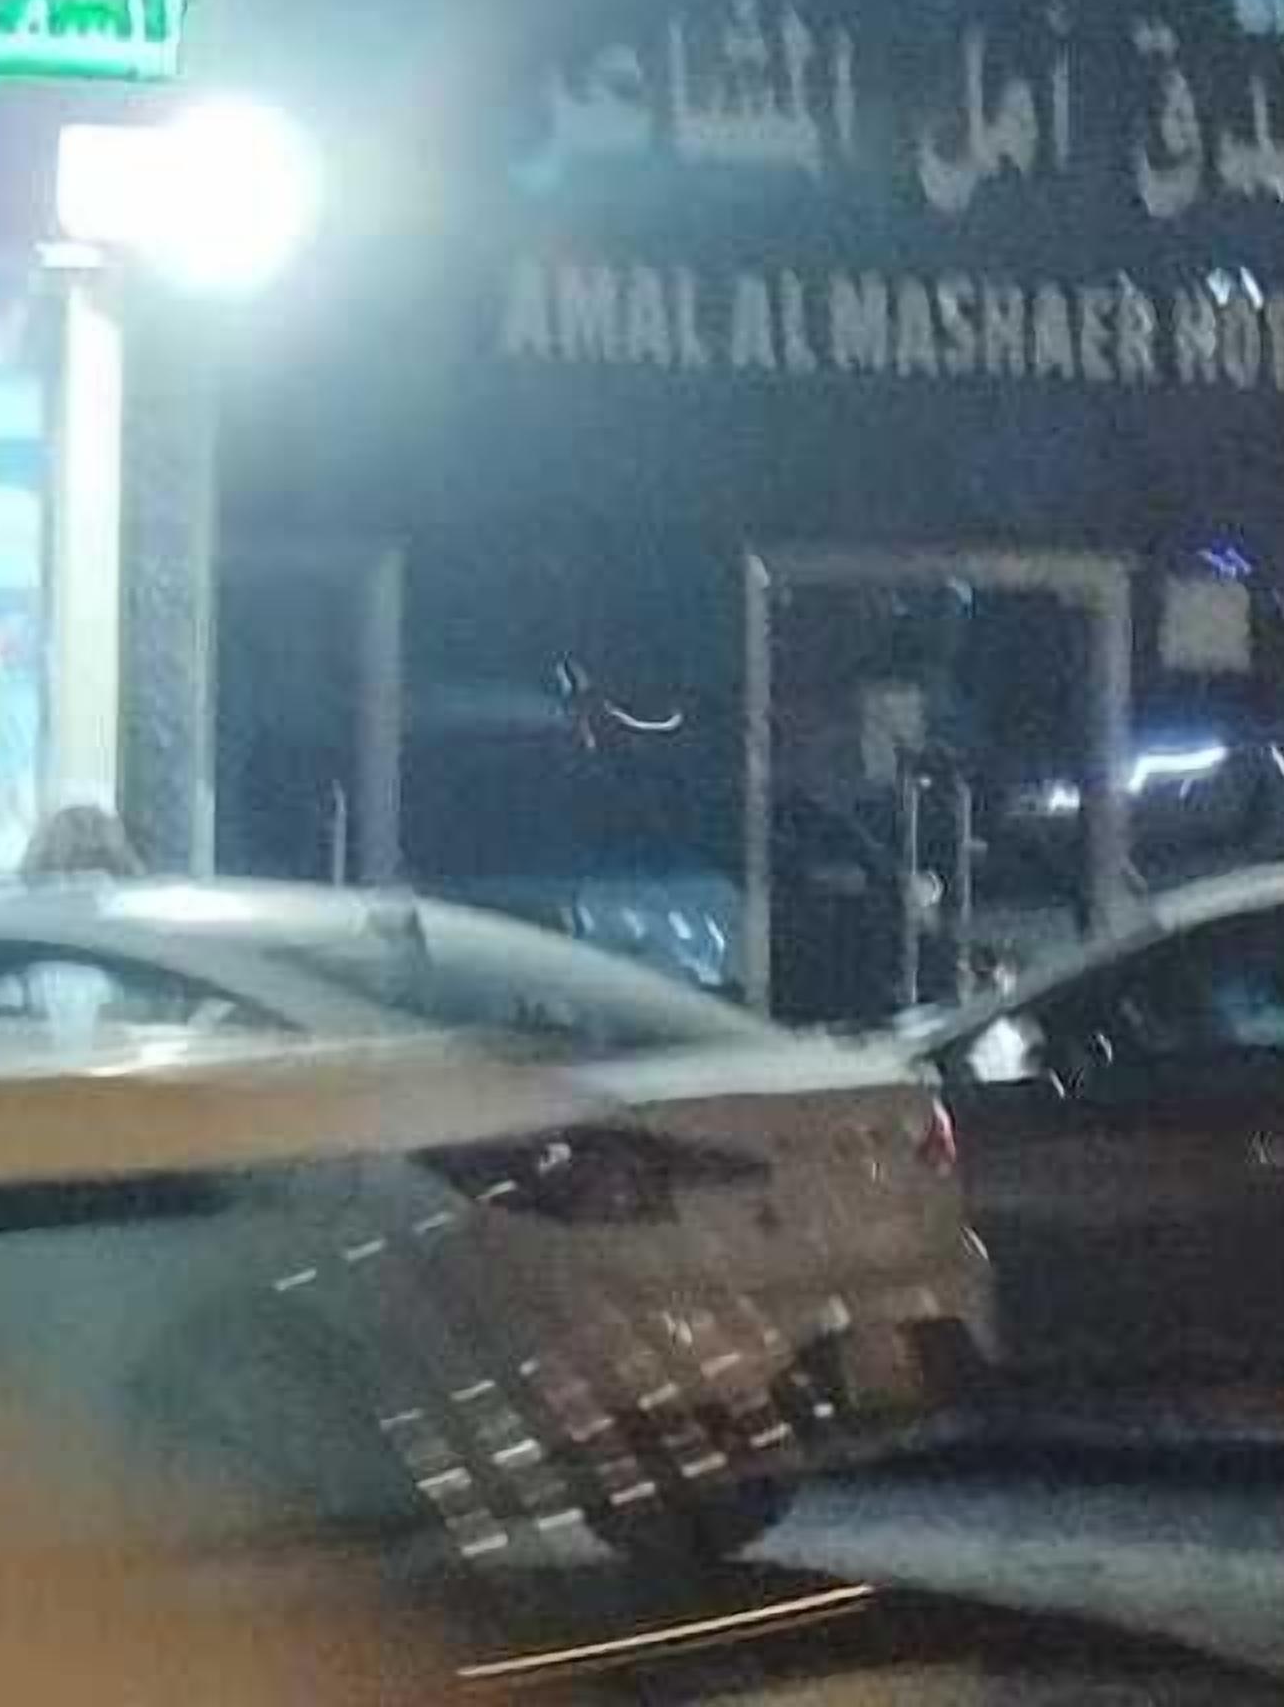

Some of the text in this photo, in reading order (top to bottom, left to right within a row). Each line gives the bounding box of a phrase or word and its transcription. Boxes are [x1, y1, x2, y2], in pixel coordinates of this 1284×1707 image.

[506, 263, 708, 373] AMAL
[730, 267, 818, 375] AL
[828, 269, 1156, 385] MASHAER
